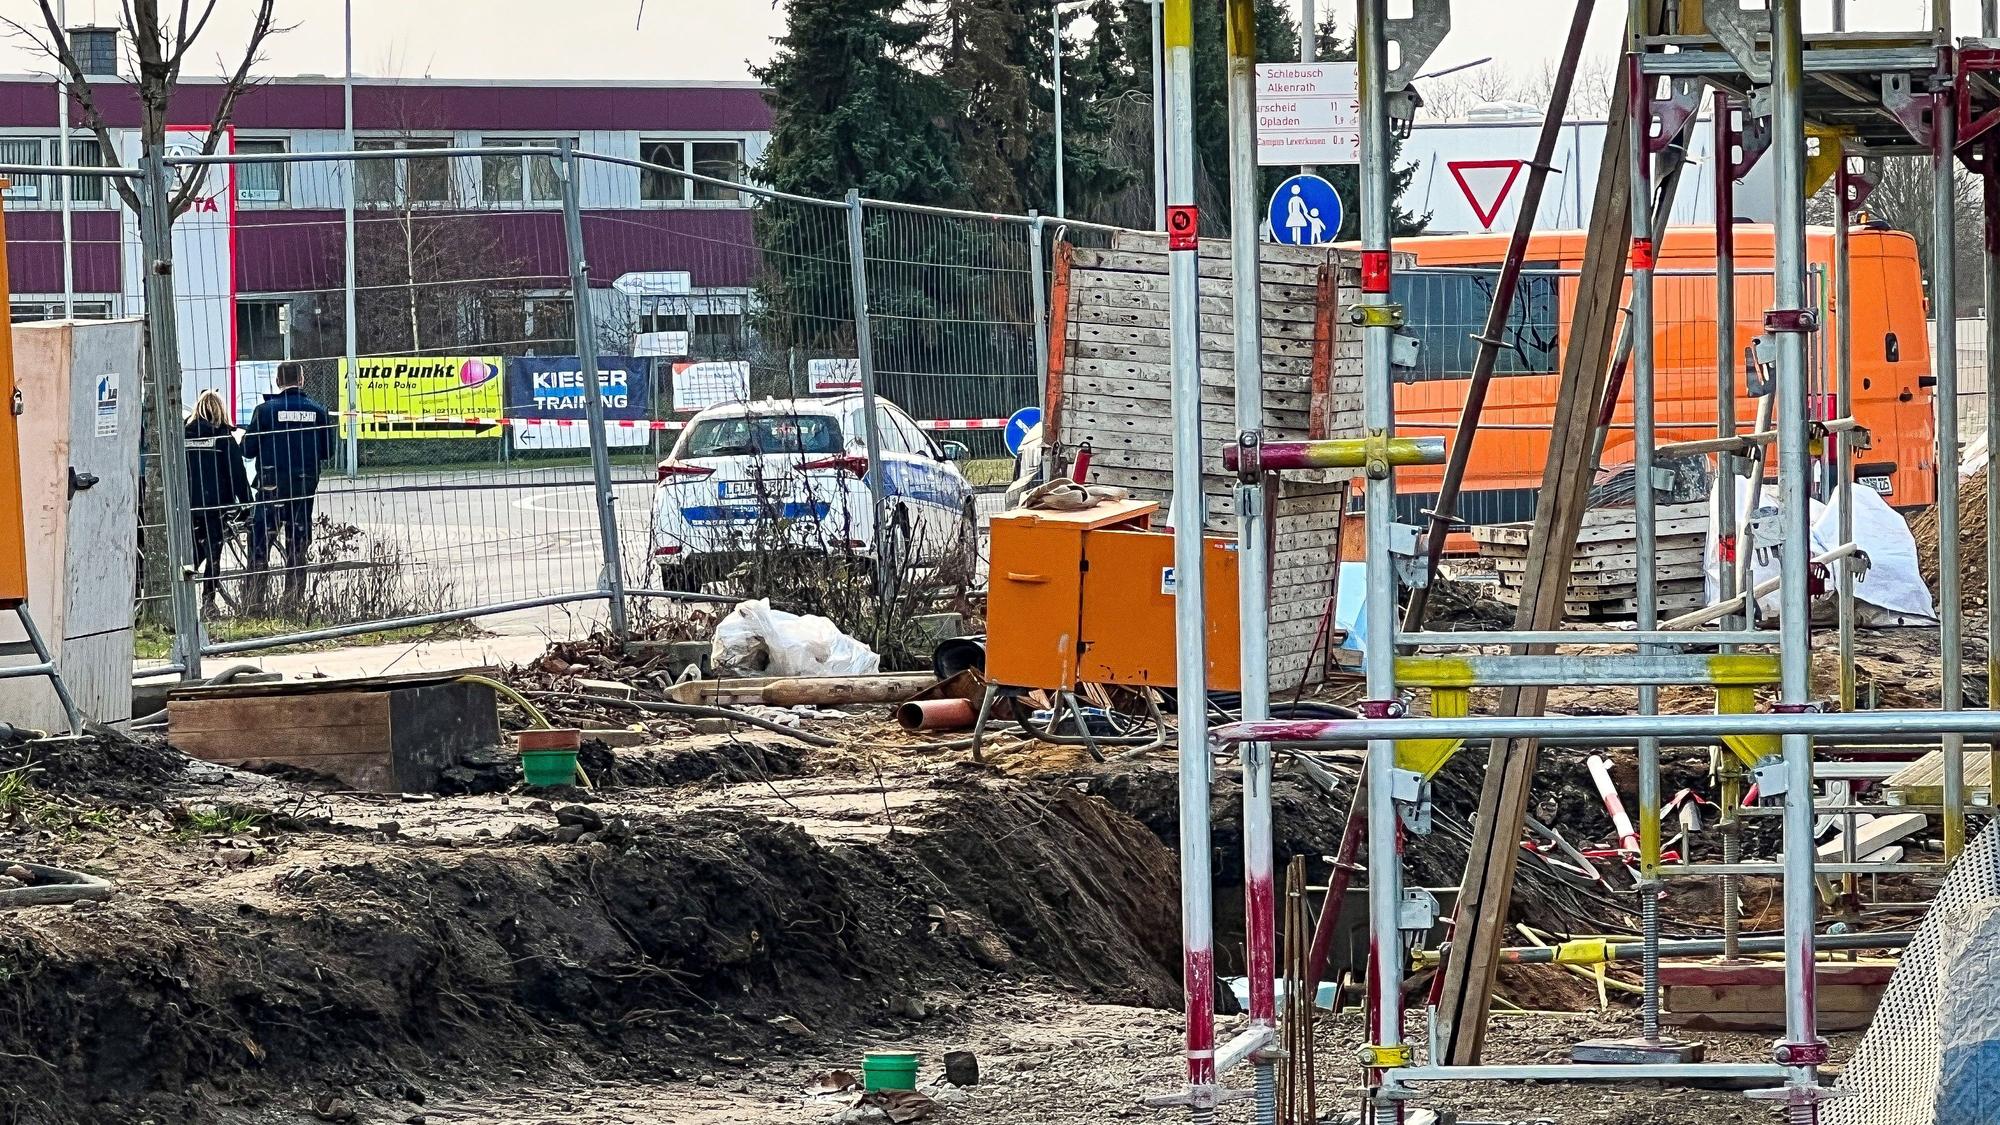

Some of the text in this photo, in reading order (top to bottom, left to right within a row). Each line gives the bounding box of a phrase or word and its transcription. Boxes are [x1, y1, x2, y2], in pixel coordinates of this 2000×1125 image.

[1267, 68, 1323, 79] Schlebusch
[1267, 83, 1316, 92] Alkenrath
[1260, 116, 1300, 128] Opladen
[1286, 136, 1326, 146] Leverkusen
